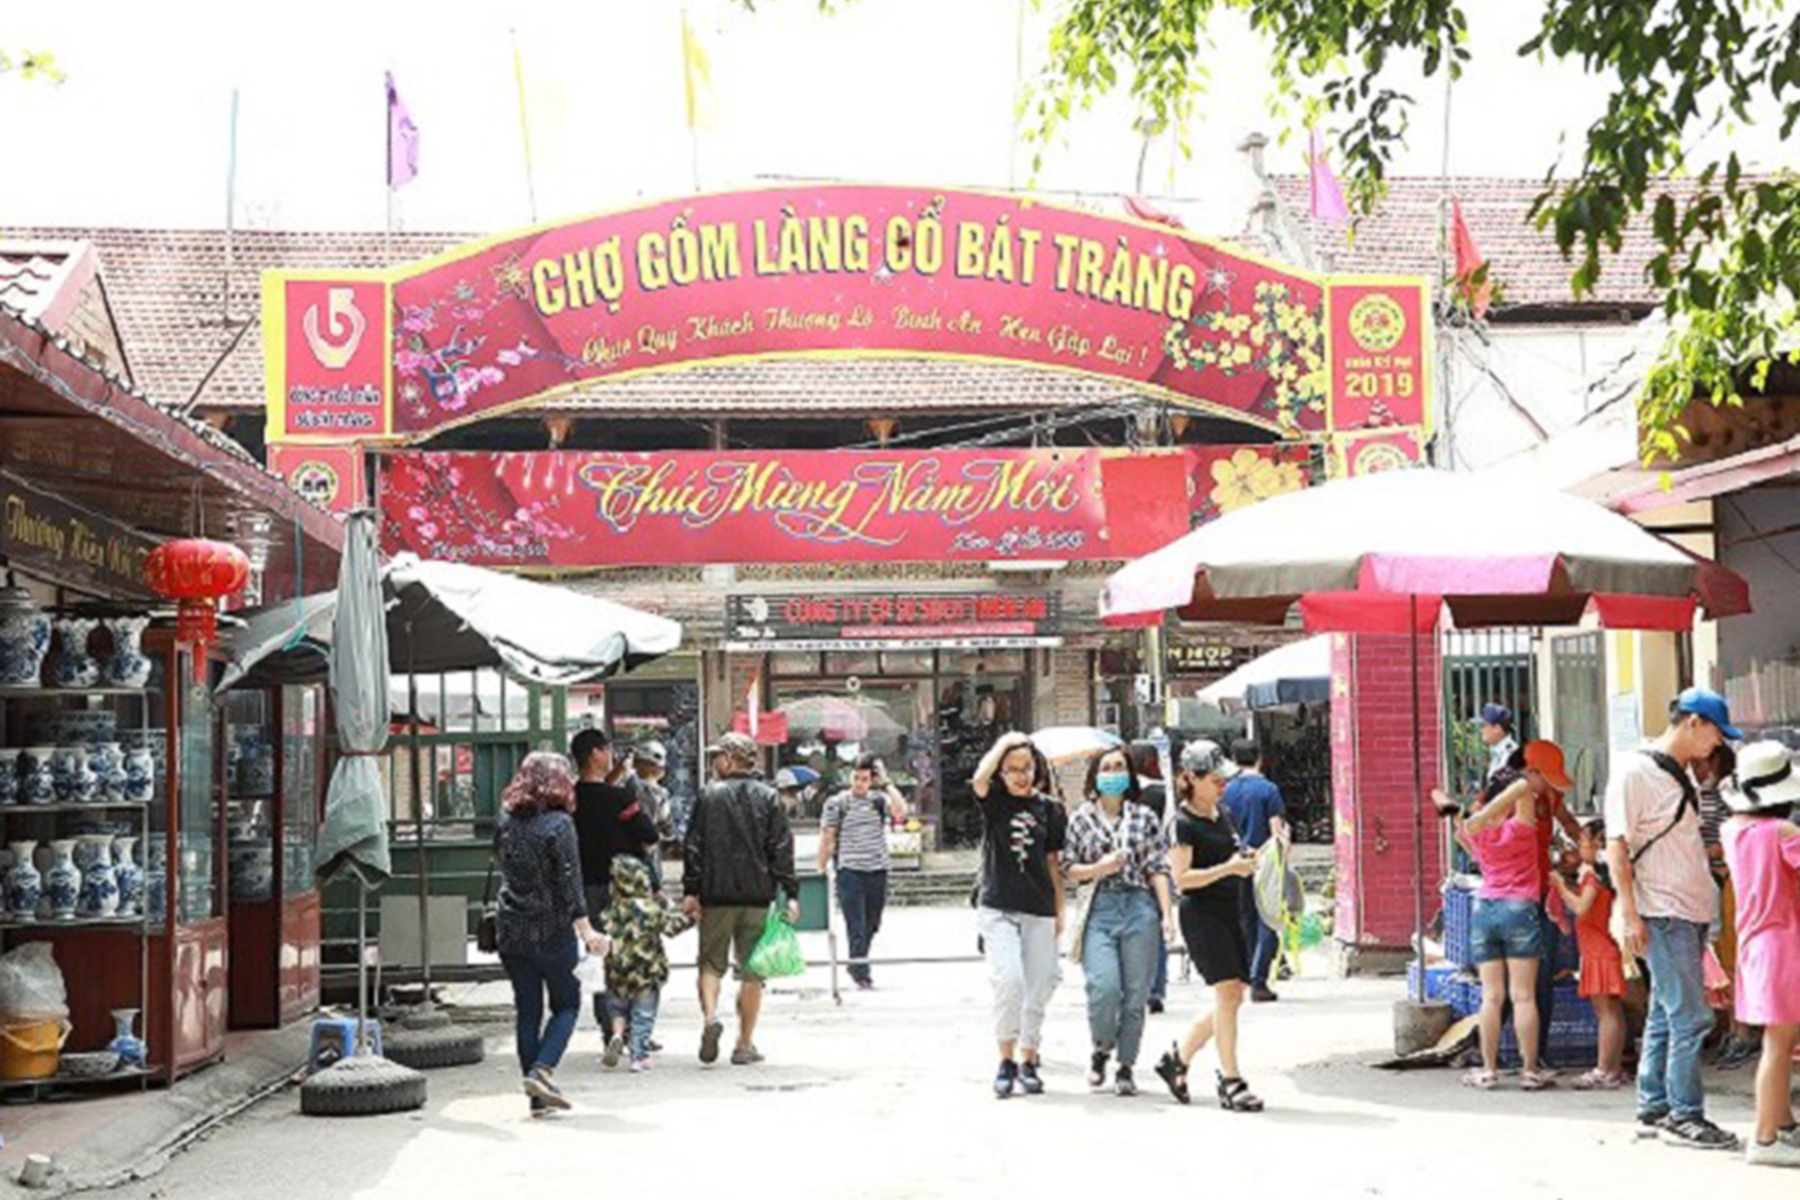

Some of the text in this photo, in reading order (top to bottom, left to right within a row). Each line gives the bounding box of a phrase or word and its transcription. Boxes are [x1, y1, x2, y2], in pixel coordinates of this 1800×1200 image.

[531, 196, 1195, 321] CHỢ GỐM LÀNG CỔ BÁT TRÀNG
[686, 310, 754, 342] Khách
[1345, 372, 1413, 397] 2019
[579, 458, 1079, 541] Chúc Mừng Năm Mới
